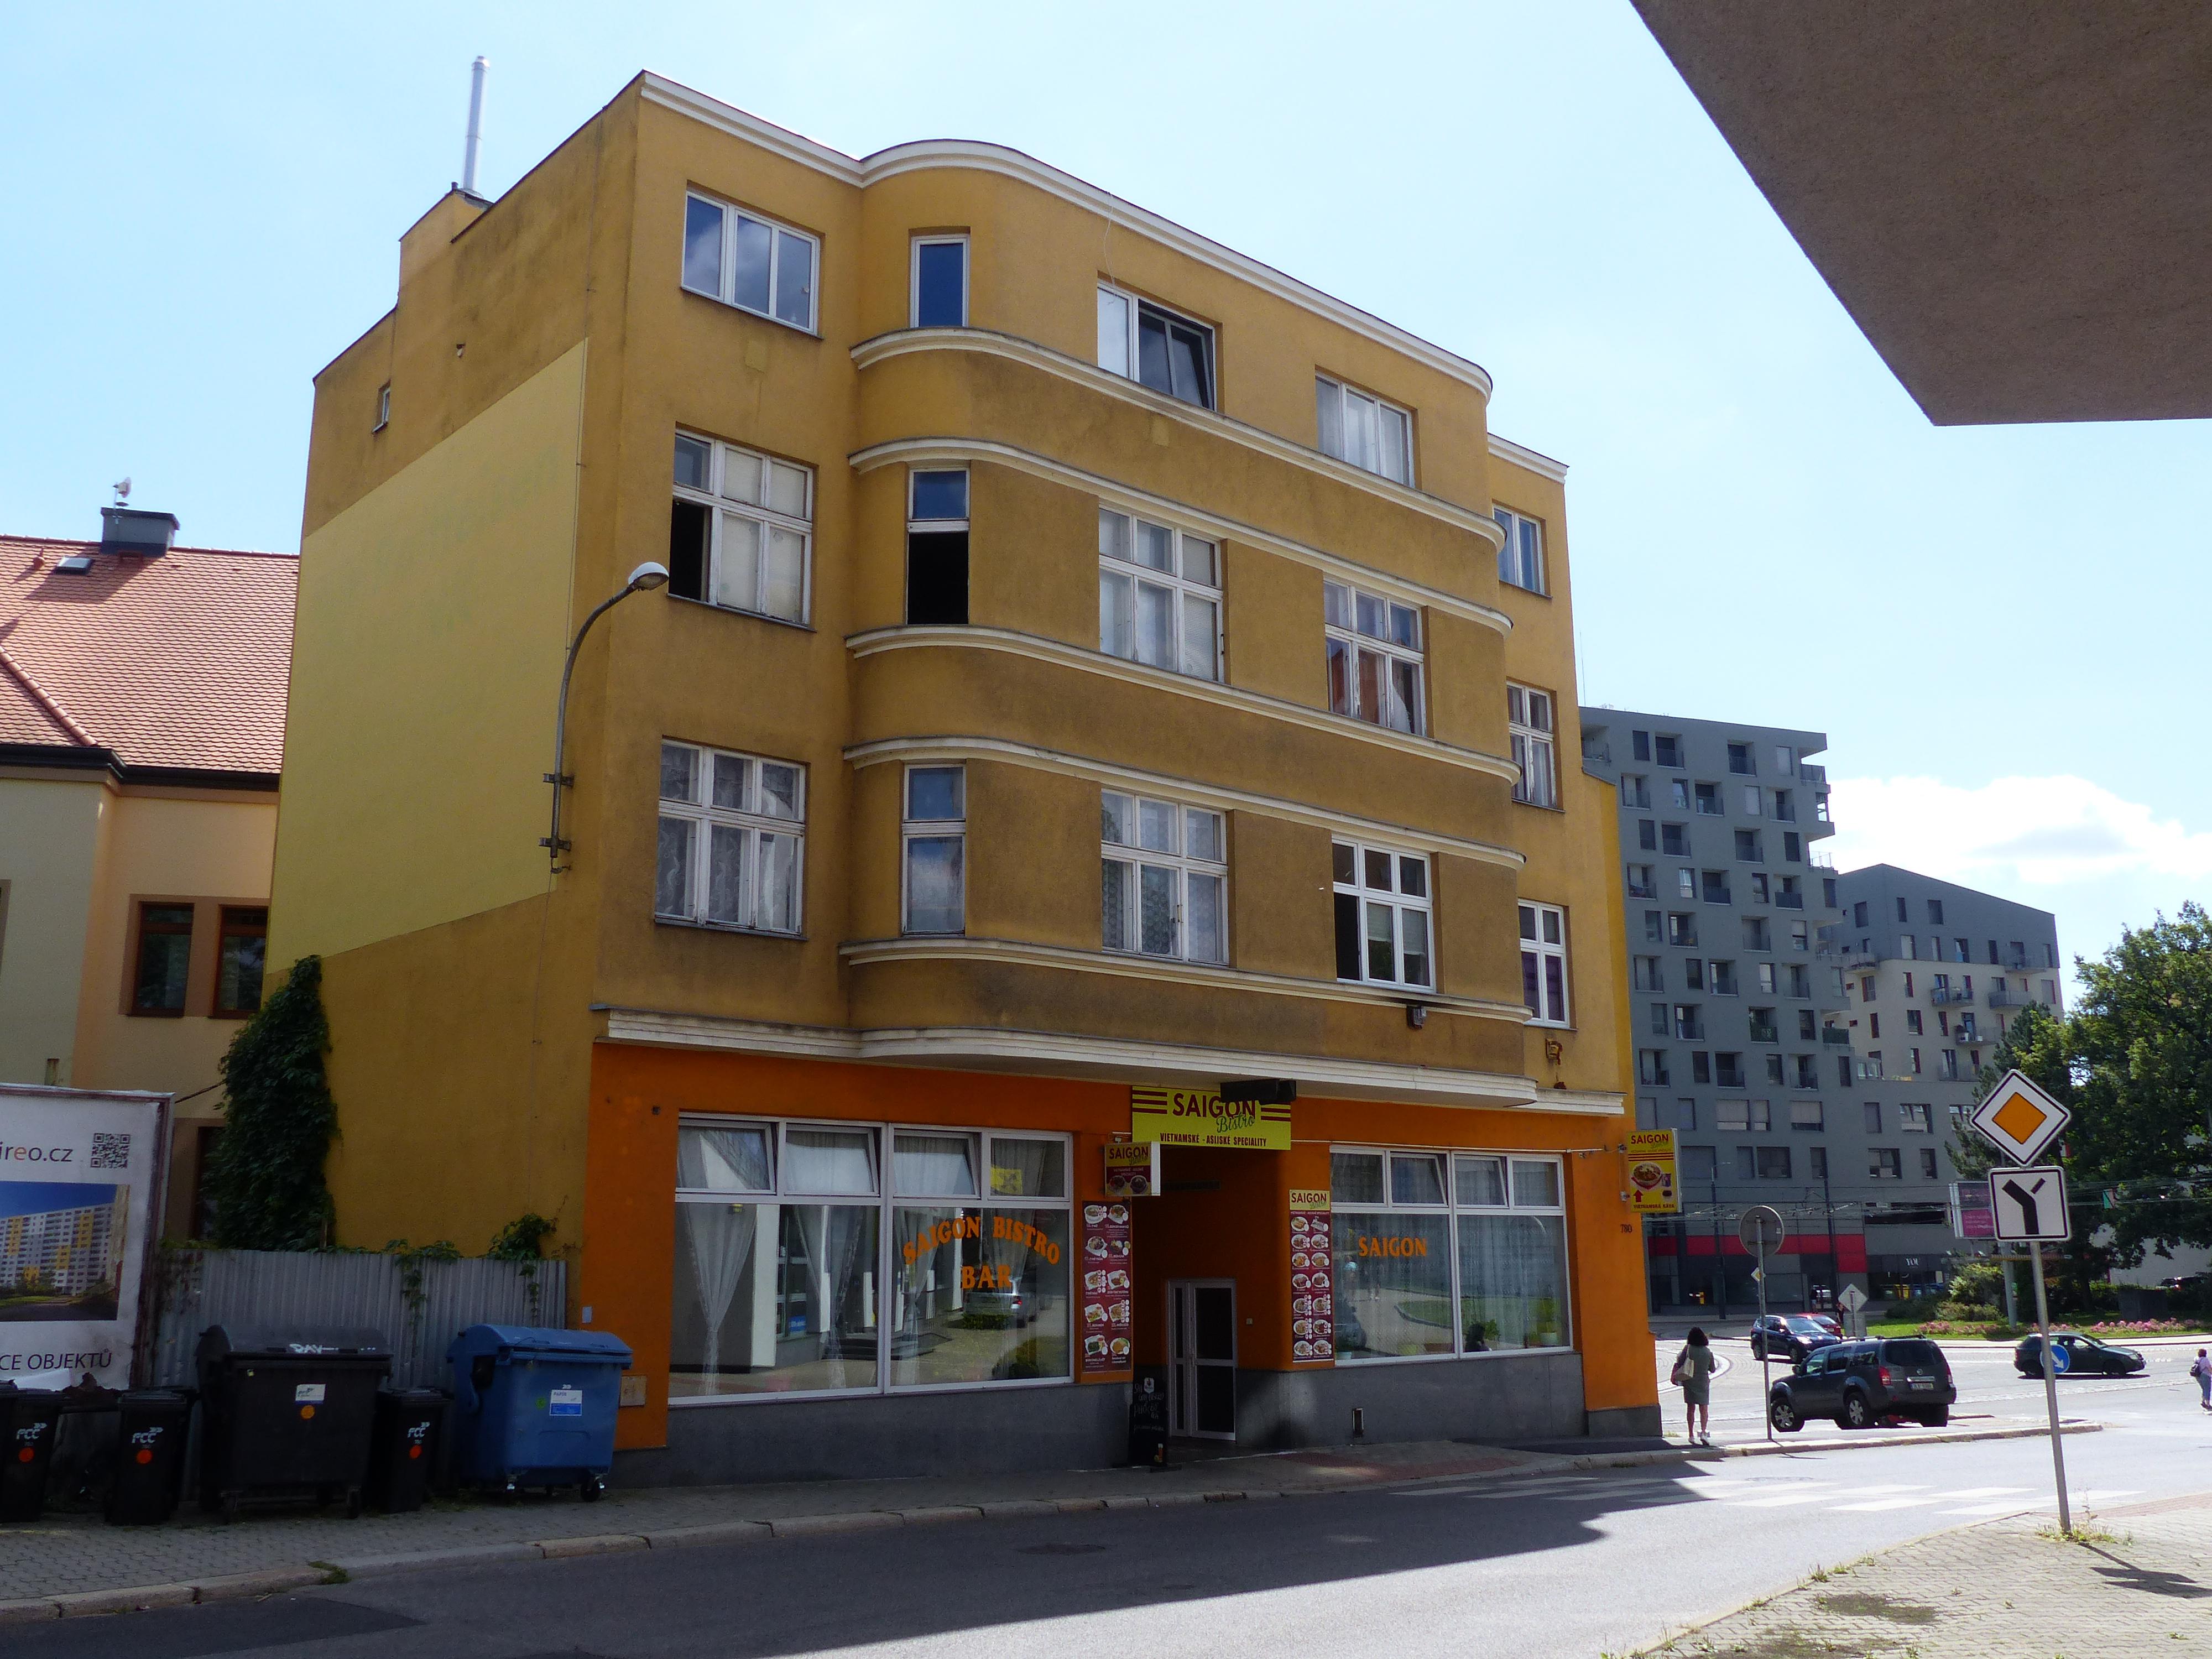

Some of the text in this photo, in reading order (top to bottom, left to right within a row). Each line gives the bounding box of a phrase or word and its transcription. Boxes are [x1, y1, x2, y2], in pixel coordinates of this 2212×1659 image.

[1172, 1093, 1255, 1119] SAIGON
[1217, 1112, 1255, 1133] Bistro
[1160, 1133, 1199, 1143] VIETNAMSKÉ
[1234, 1137, 1267, 1146] SPECIALITY
[1631, 1134, 1669, 1144] SAIGON
[1110, 1147, 1149, 1159] SAIGON
[1291, 1193, 1327, 1203] SAIGON
[1620, 1224, 1632, 1233] 780
[903, 1215, 1060, 1265] SAIGON BISTRO
[1358, 1236, 1427, 1257] SAIGON
[961, 1264, 1012, 1290] BAR
[28, 1348, 112, 1369] OBJEKTŮ
